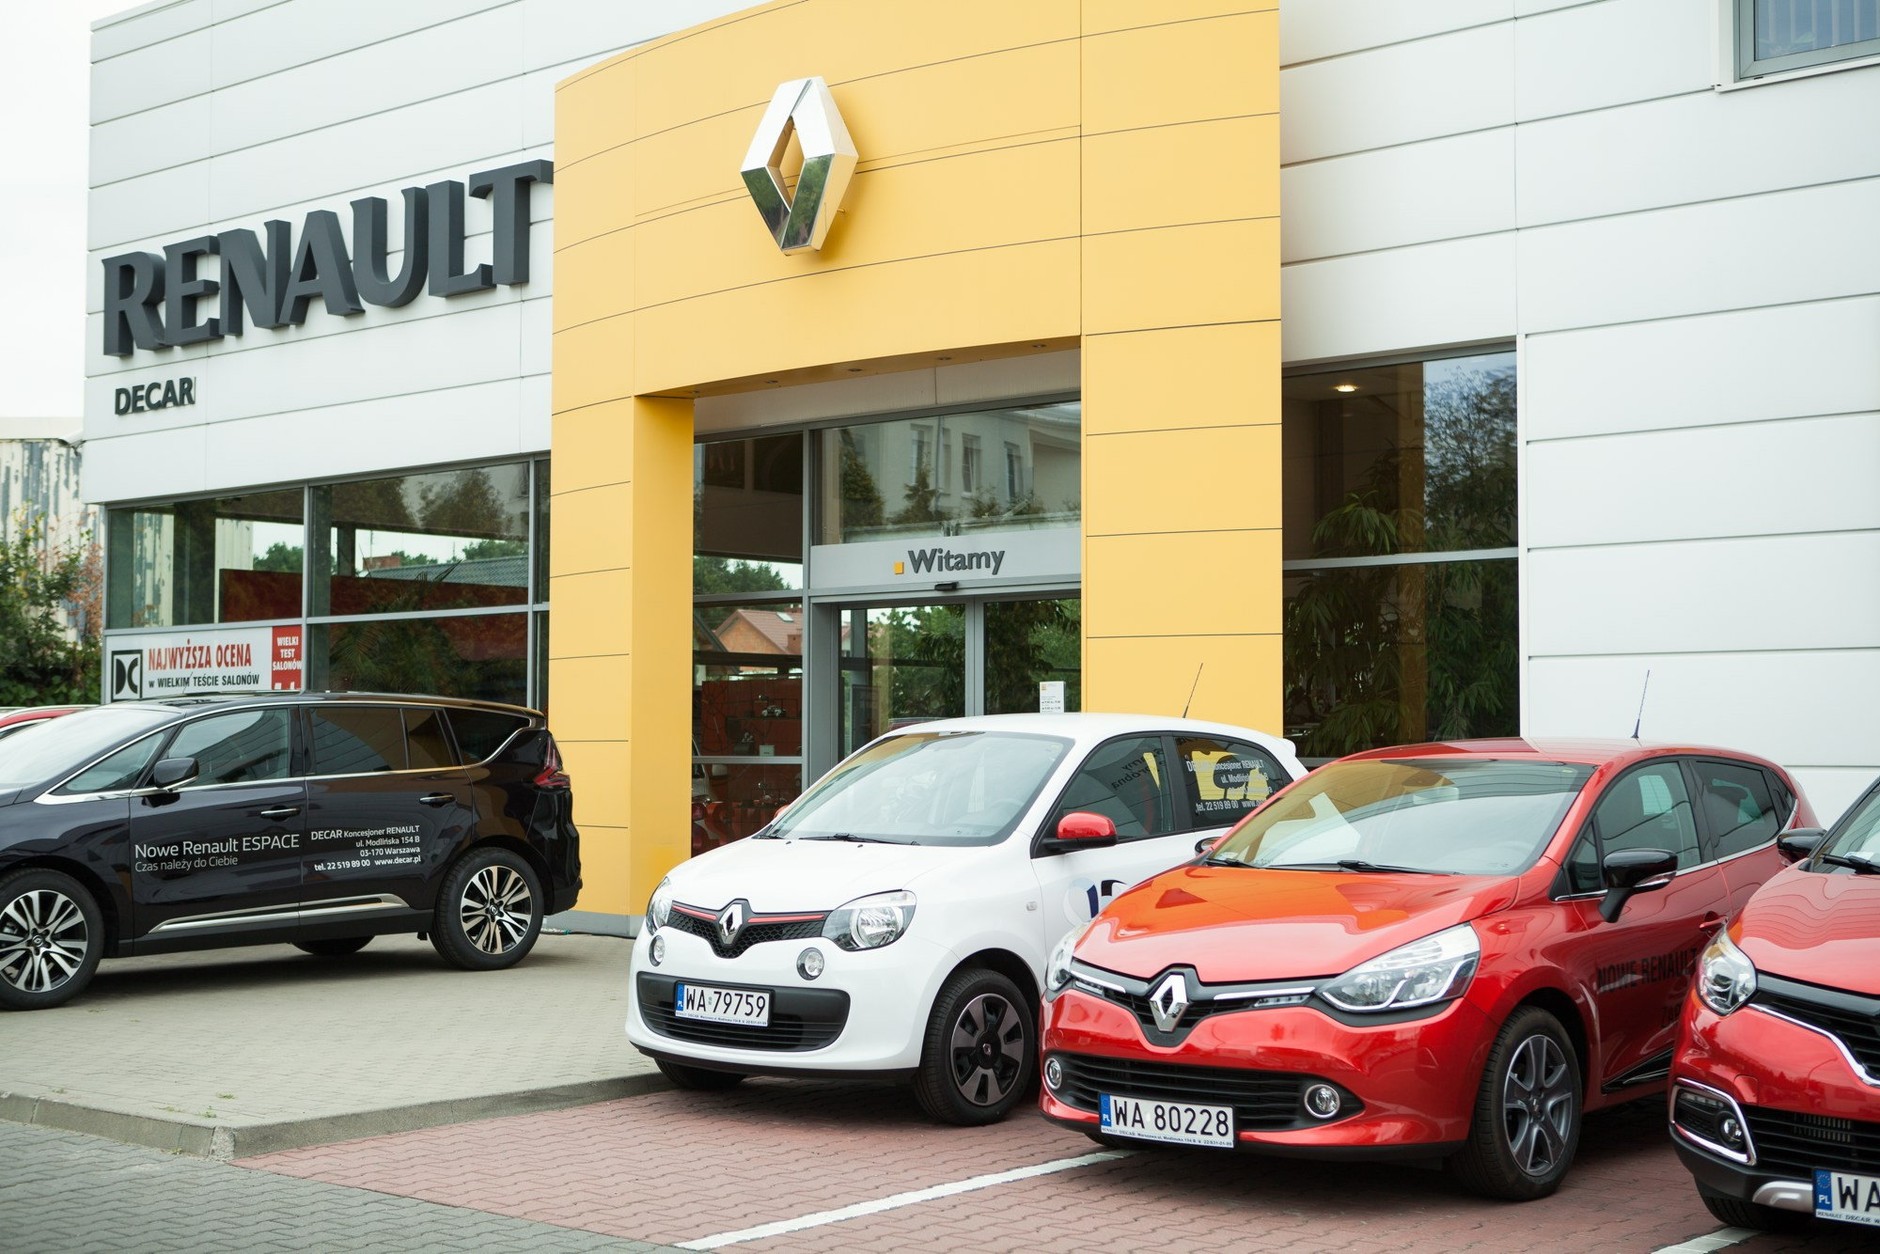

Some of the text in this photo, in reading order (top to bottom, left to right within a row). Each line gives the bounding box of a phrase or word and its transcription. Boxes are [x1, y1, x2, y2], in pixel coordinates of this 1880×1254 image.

[101, 159, 554, 357] RENAULT
[115, 376, 196, 415] DECAR
[907, 548, 1006, 575] Witamy
[276, 636, 299, 647] WIELKI
[149, 638, 252, 671] NAJWYŻSZA OCENA
[279, 648, 295, 658] TEST
[157, 677, 190, 689] WIELKIM
[193, 673, 220, 687] TEŚCIE
[222, 672, 260, 687] SALONÓW
[311, 825, 420, 840] DECAR Koncesjoner RENAULT
[401, 836, 413, 844] 154
[414, 835, 420, 843] B
[135, 834, 300, 858] Nowe Renault ESPACE
[360, 847, 420, 857] 03-170 Warszawa
[135, 855, 238, 873] Czas należy do Ciebie
[314, 855, 421, 872] tel. 22 519 89 00 www.decar.pl
[686, 988, 706, 1012] WA
[713, 991, 766, 1018] 79759
[1102, 1100, 1229, 1137] PL WA 80228
[1818, 1194, 1831, 1205] PL
